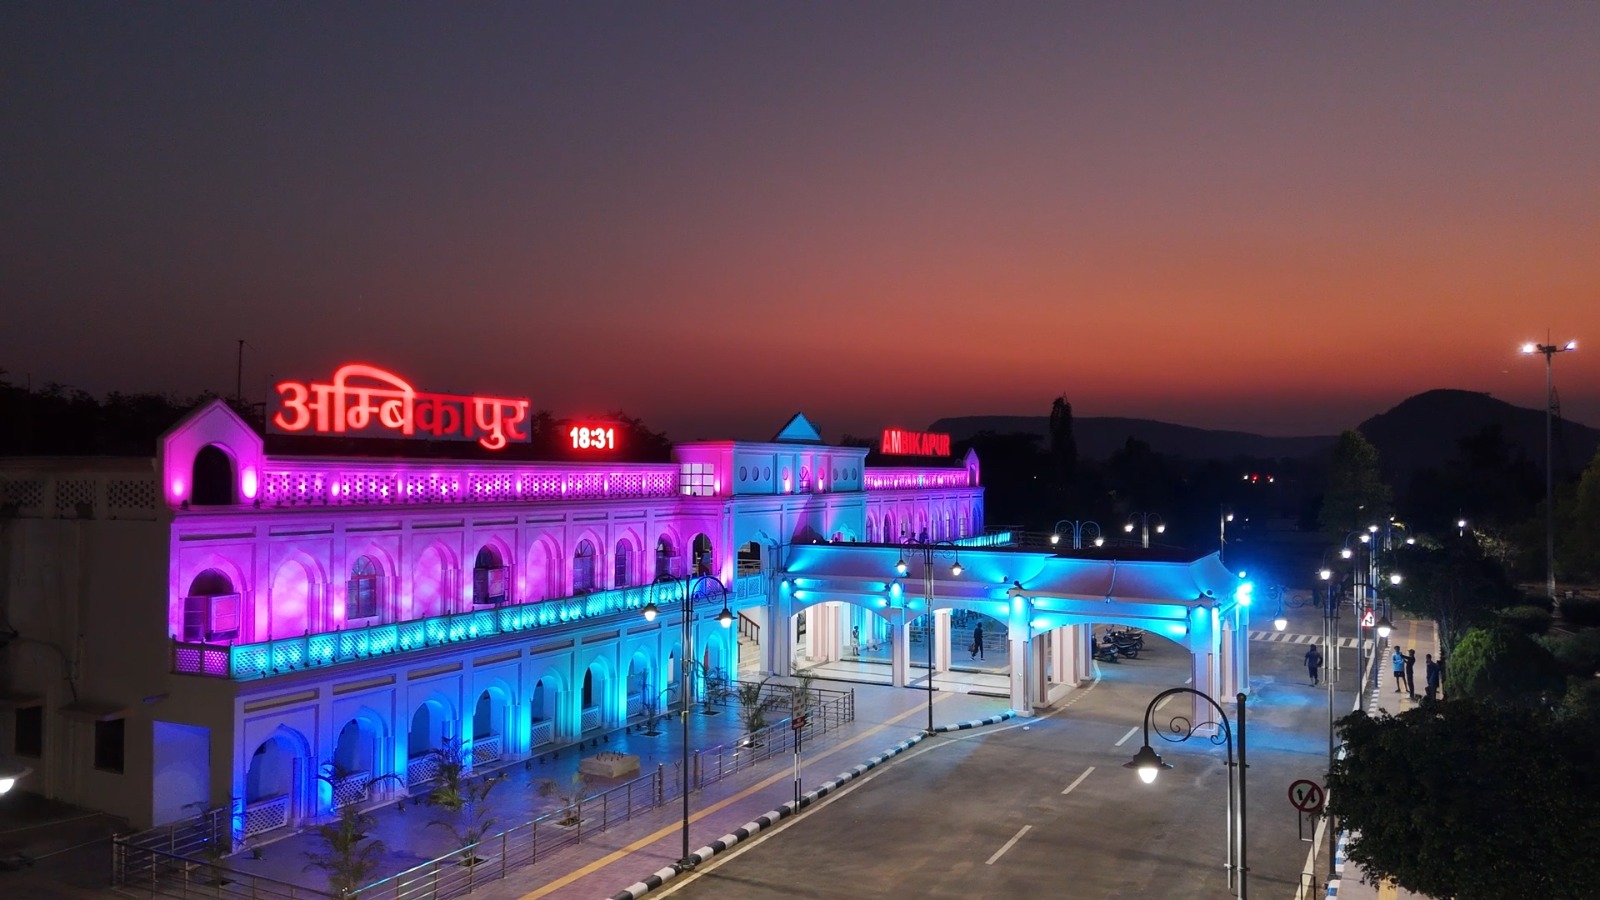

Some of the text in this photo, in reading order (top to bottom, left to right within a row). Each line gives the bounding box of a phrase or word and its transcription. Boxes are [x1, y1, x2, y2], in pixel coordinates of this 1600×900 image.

[275, 363, 529, 449] अम्बिकापुर
[569, 426, 616, 450] 18:31
[882, 429, 950, 456] AMBIKAPUR
